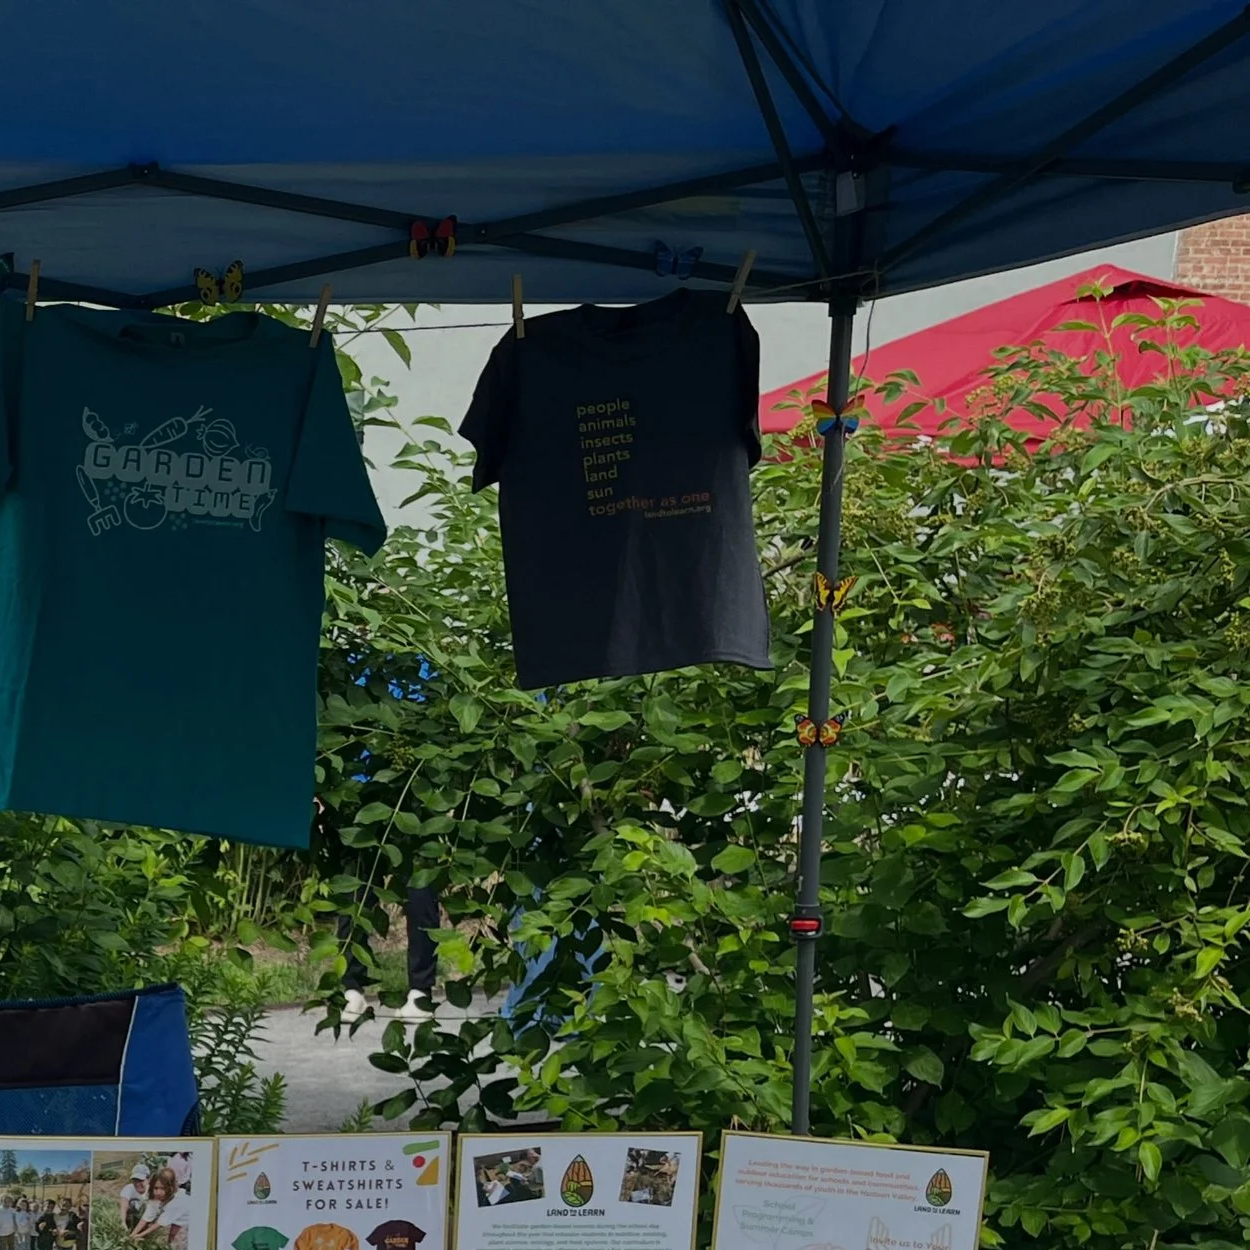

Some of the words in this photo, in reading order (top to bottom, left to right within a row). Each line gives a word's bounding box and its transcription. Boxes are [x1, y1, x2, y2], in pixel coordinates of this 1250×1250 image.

[576, 397, 630, 418] people
[579, 414, 637, 432] animals
[580, 433, 634, 449] insects
[93, 444, 266, 484] GARDEN
[583, 450, 631, 469] plants
[585, 465, 618, 482] land
[171, 486, 251, 511] TIME
[587, 487, 614, 499] sun
[588, 496, 655, 516] together
[660, 496, 676, 507] as
[681, 492, 710, 504] one
[302, 1160, 376, 1172] T-SHIRTS
[384, 1160, 395, 1171] &
[292, 1178, 403, 1191] SWEATSHIRTS
[306, 1199, 337, 1210] FOR
[345, 1198, 389, 1210] SALE!
[764, 1200, 795, 1210] School
[547, 1208, 569, 1217] LAND
[578, 1208, 605, 1217] LEARN
[741, 1209, 806, 1226] Programming
[740, 1222, 780, 1233] Summer
[869, 1236, 897, 1246] Invite
[913, 1241, 924, 1249] to
[925, 1241, 949, 1250] Your
